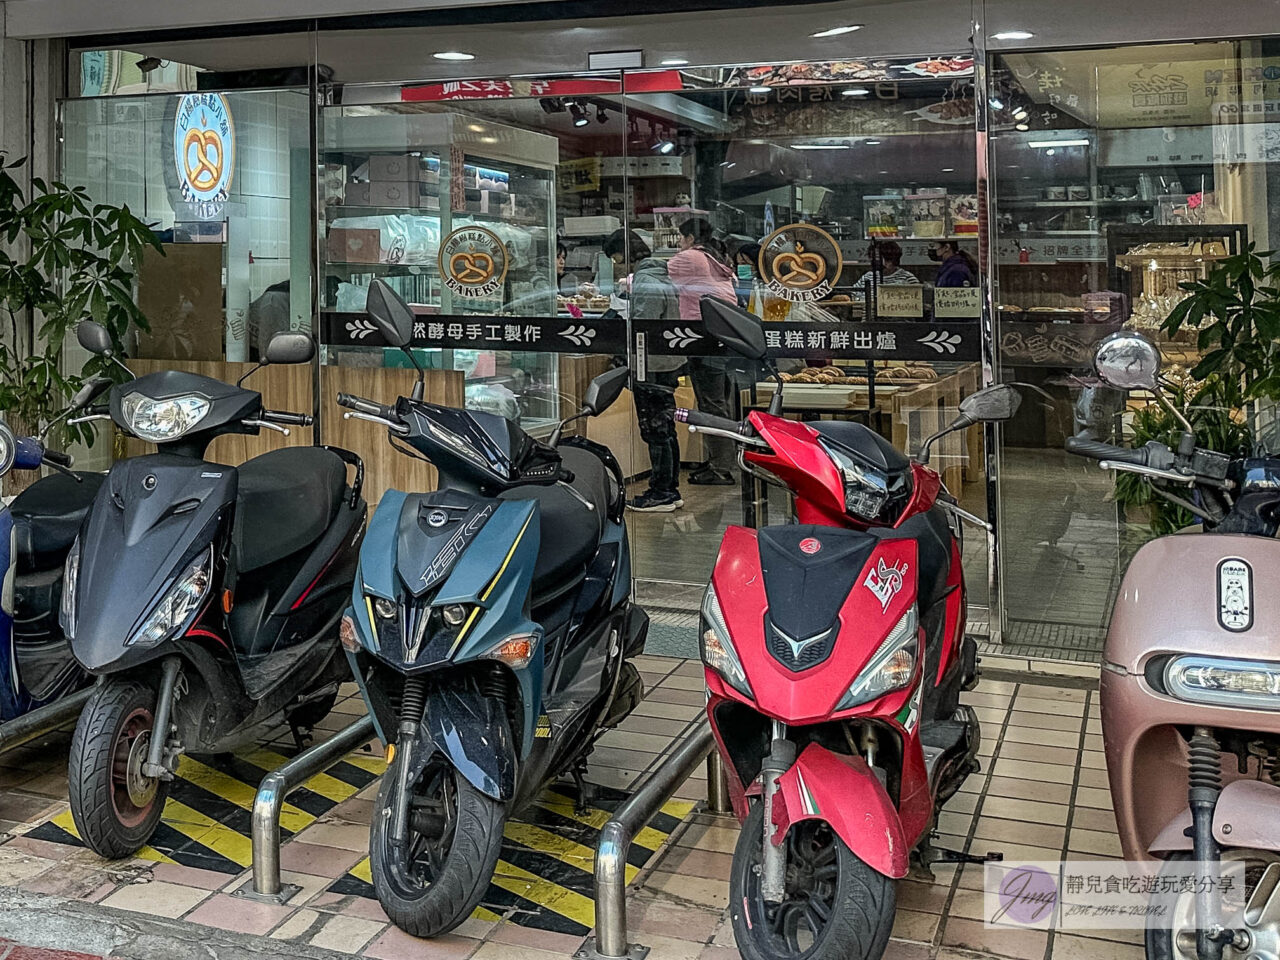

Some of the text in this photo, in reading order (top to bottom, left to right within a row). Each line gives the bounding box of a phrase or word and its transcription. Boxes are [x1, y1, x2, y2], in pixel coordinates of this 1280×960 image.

[445, 278, 500, 297] BAKERY
[766, 279, 832, 301] BAKERY
[413, 322, 541, 342] 然酵母手工製作
[764, 330, 897, 351] 蛋糕新鮮出爐
